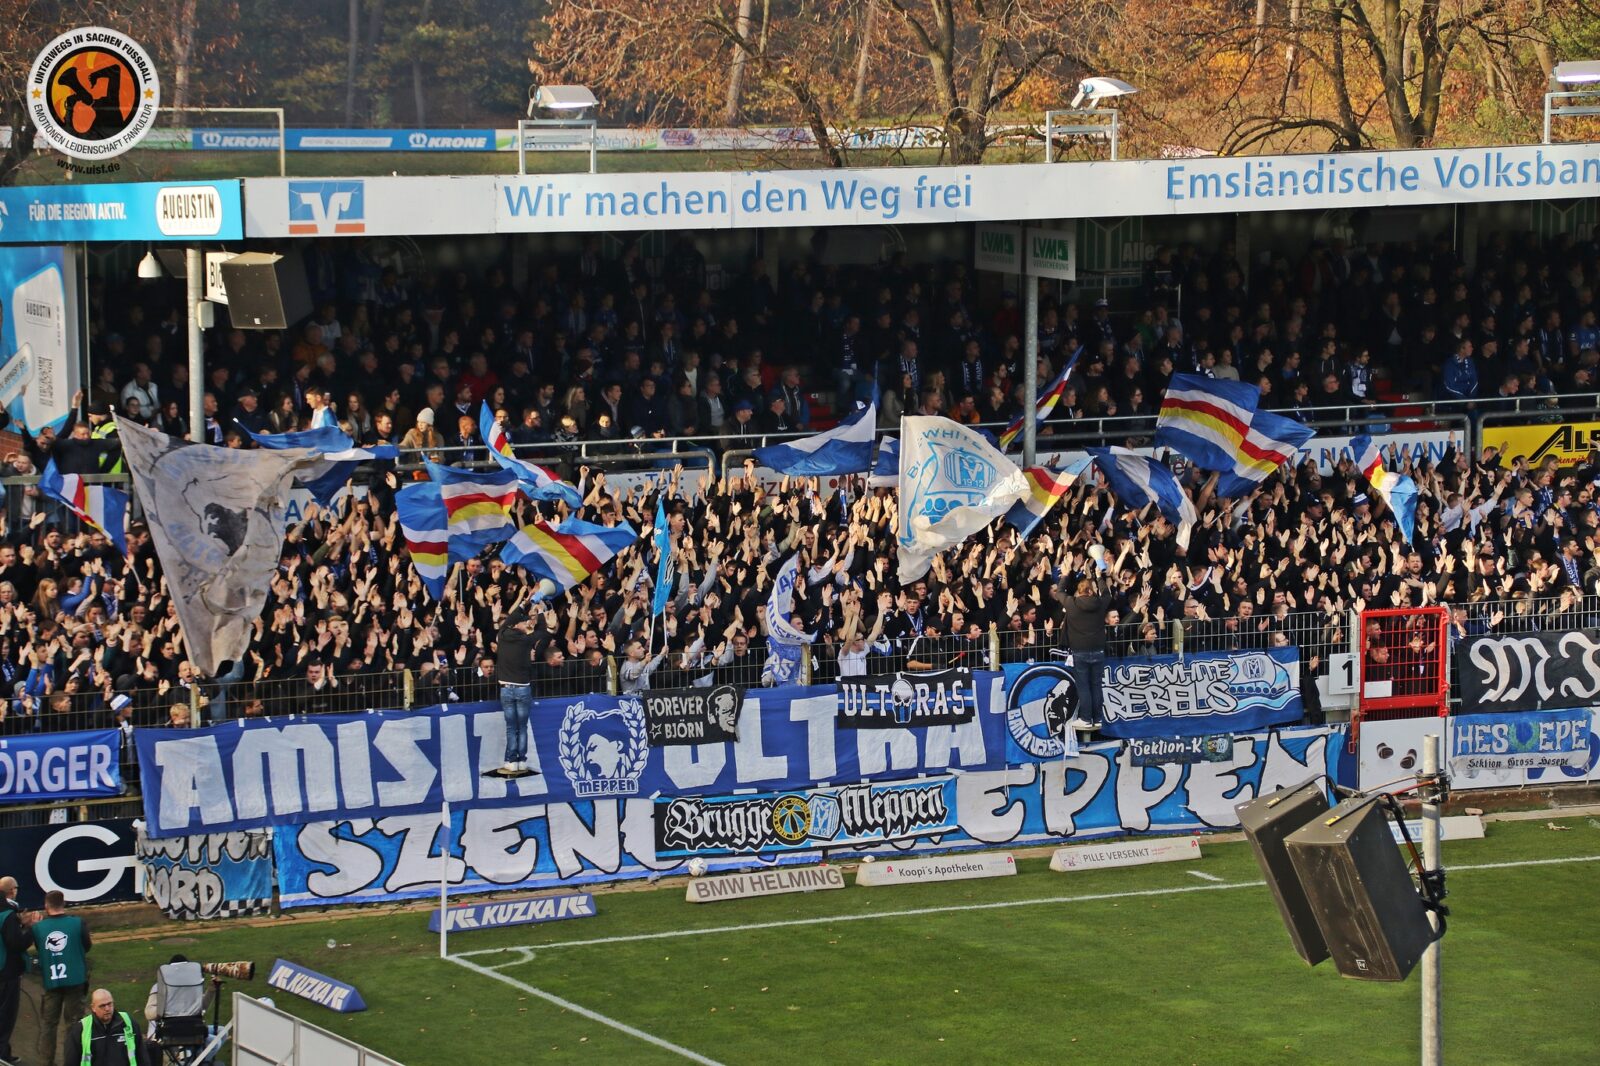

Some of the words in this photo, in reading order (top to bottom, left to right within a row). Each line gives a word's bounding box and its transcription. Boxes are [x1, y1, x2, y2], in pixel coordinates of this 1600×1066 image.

[221, 135, 281, 148] KRONE
[427, 136, 488, 148] KRONE
[1167, 158, 1420, 201] Emsländische
[163, 193, 215, 219] AUGUSTIN
[504, 183, 572, 218] Wir
[585, 181, 728, 217] machen
[741, 178, 807, 213] den
[821, 178, 900, 219] Weg
[914, 173, 972, 208] frei
[29, 199, 46, 221] FÜR
[47, 203, 62, 220] DIE
[63, 203, 96, 220] REGION
[98, 202, 127, 220] AKTIV.
[1033, 237, 1069, 260] LVM
[26, 301, 51, 319] AUGUSTIN
[1103, 664, 1152, 688] LUE
[1341, 660, 1353, 687] 1
[647, 696, 704, 719] FOREVER
[842, 679, 965, 717] ULTRAS
[1103, 681, 1238, 723] REBELS
[664, 718, 704, 739] BJÖRN
[1133, 736, 1203, 757] Sektion-K
[1467, 758, 1502, 770] Sektion
[578, 779, 636, 794] MEPPEN
[952, 729, 1326, 844] EPPEN
[669, 800, 774, 846] Brugge
[839, 785, 945, 833] Meppen
[1083, 852, 1105, 863] PILLE
[1106, 848, 1150, 861] VERSENKT
[934, 861, 984, 877] Apotheken
[695, 876, 745, 899] BMW
[750, 869, 841, 892] HELMING
[481, 899, 556, 926] KUZKA
[50, 963, 67, 980] 12
[286, 972, 333, 1003] KUZKA
